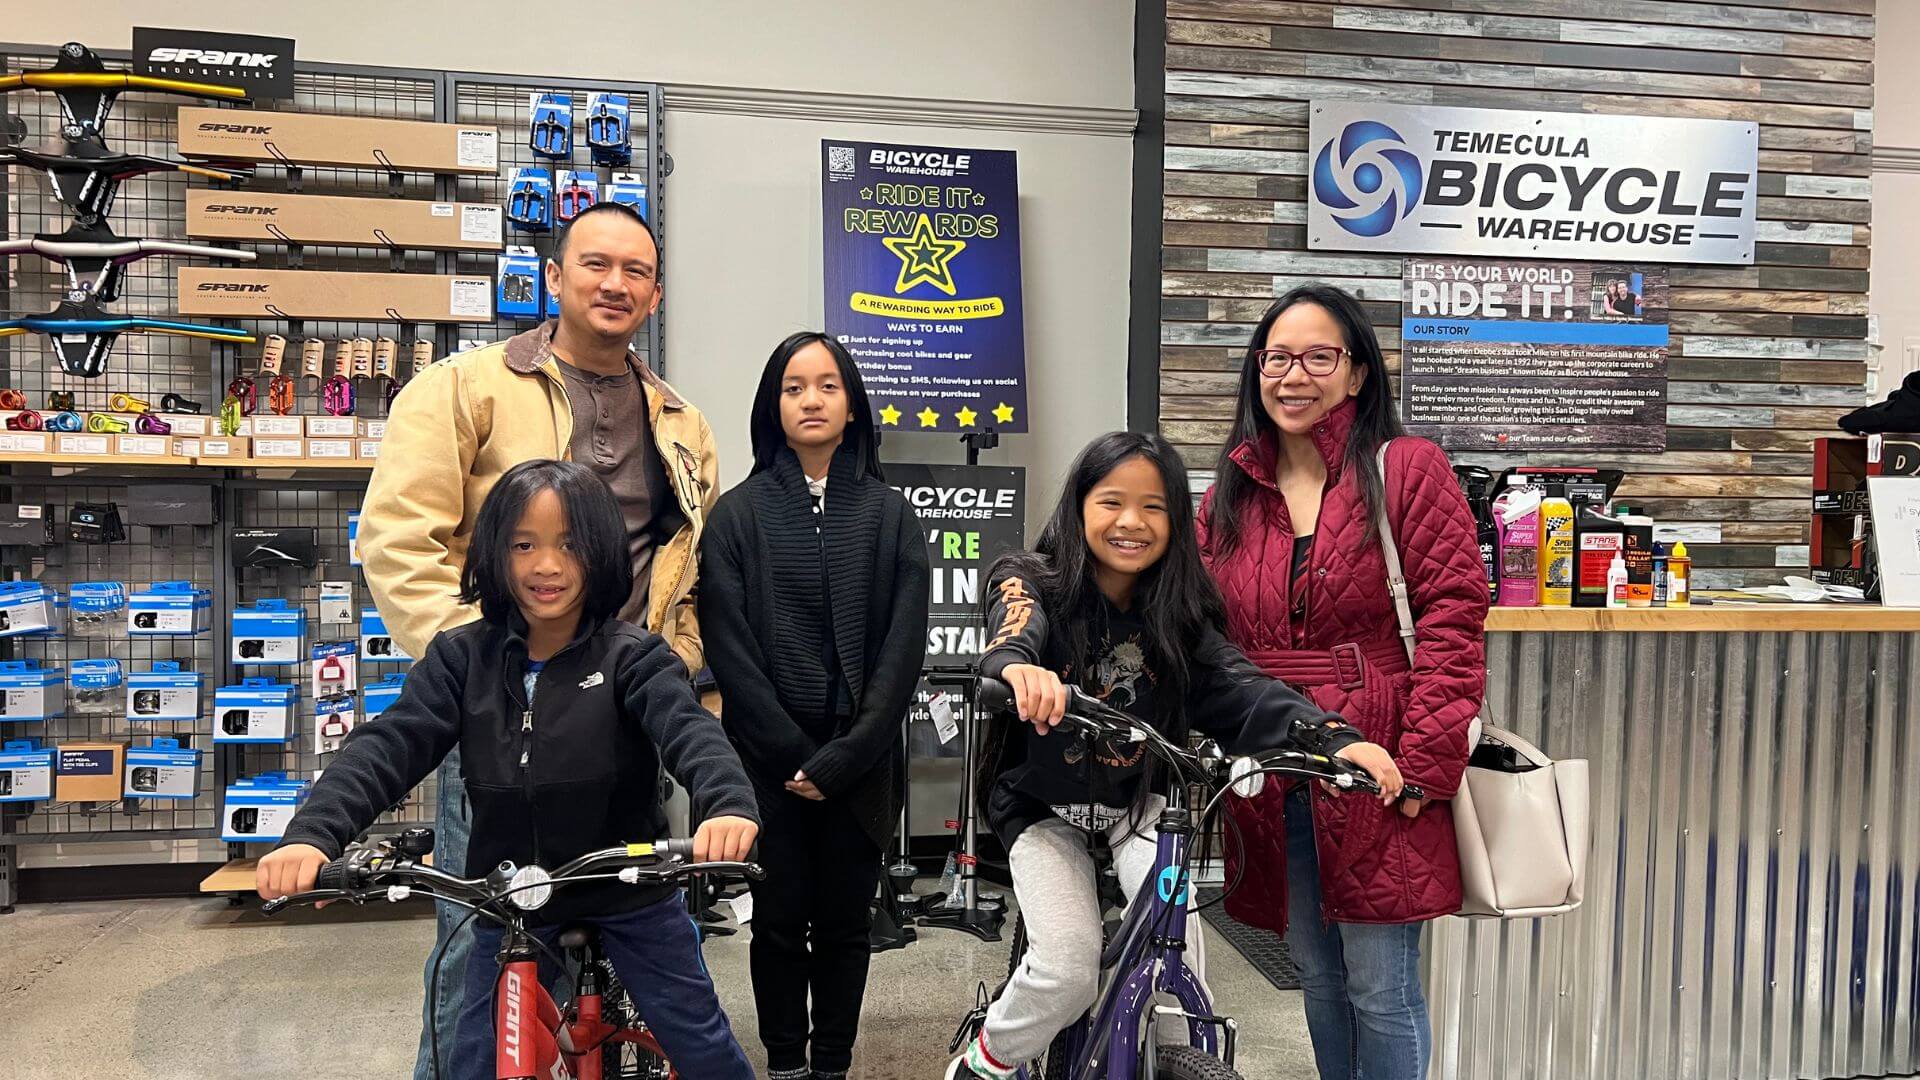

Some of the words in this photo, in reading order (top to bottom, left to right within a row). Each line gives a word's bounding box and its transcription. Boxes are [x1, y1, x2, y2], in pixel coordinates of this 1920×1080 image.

[148, 66, 274, 79] INDUSTRIES
[1433, 130, 1590, 158] TEMECULA
[870, 150, 970, 169] BICYCLE
[886, 166, 954, 176] WAREHOUSE
[1423, 160, 1750, 218] BICYCLE
[876, 184, 940, 207] RIDE
[946, 188, 972, 208] IT
[1477, 217, 1694, 245] WAREHOUSE
[1411, 264, 1444, 280] IT'S
[1450, 265, 1502, 282] YOUR
[1508, 267, 1574, 284] WORLD
[1412, 281, 1508, 318] RIDE
[1522, 284, 1574, 319] IT!
[870, 300, 930, 314] REWARDING
[973, 302, 996, 312] RIDE
[888, 323, 917, 332] WAYS
[919, 324, 933, 332] TO
[936, 324, 963, 333] EARN
[1414, 325, 1434, 334] OUR
[1438, 326, 1470, 336] STORY
[850, 336, 866, 344] Just
[868, 336, 880, 344] for
[882, 337, 911, 346] signing
[913, 338, 924, 346] up
[851, 350, 894, 358] Purchasing
[896, 350, 913, 358] cool
[914, 350, 936, 358] bikes
[1428, 347, 1454, 355] started
[1502, 348, 1514, 356] dad
[1516, 348, 1532, 356] took
[1586, 350, 1618, 358] mountain
[1618, 350, 1632, 358] bike
[1427, 356, 1452, 364] hooked
[1453, 356, 1466, 364] and
[1472, 358, 1487, 366] year
[1514, 358, 1530, 366] 1992
[1532, 359, 1547, 367] they
[1548, 360, 1564, 368] gave
[1536, 368, 1556, 376] today
[1566, 368, 1590, 377] Bicycle
[862, 376, 899, 385] bscribing
[900, 376, 909, 384] to
[911, 376, 931, 384] SMS,
[932, 377, 970, 386] following
[996, 378, 1018, 386] social
[877, 388, 908, 396] reviews
[921, 390, 938, 398] your
[940, 390, 980, 398] purchases
[1431, 385, 1443, 394] day
[1470, 386, 1496, 394] mission
[1498, 386, 1508, 394] has
[1510, 387, 1534, 395] always
[1560, 388, 1583, 396] inspire
[1584, 388, 1610, 396] people's
[1437, 395, 1456, 404] enjoy
[1514, 406, 1540, 414] growing
[1542, 406, 1554, 414] this
[1569, 407, 1588, 415] Diego
[1590, 408, 1610, 416] family
[1520, 416, 1532, 424] top
[1532, 416, 1556, 424] bicycle
[1522, 434, 1540, 442] Team
[890, 486, 1016, 508] ICYCLE
[915, 508, 993, 519] AREHOUSE
[506, 970, 520, 1068] GIANT
